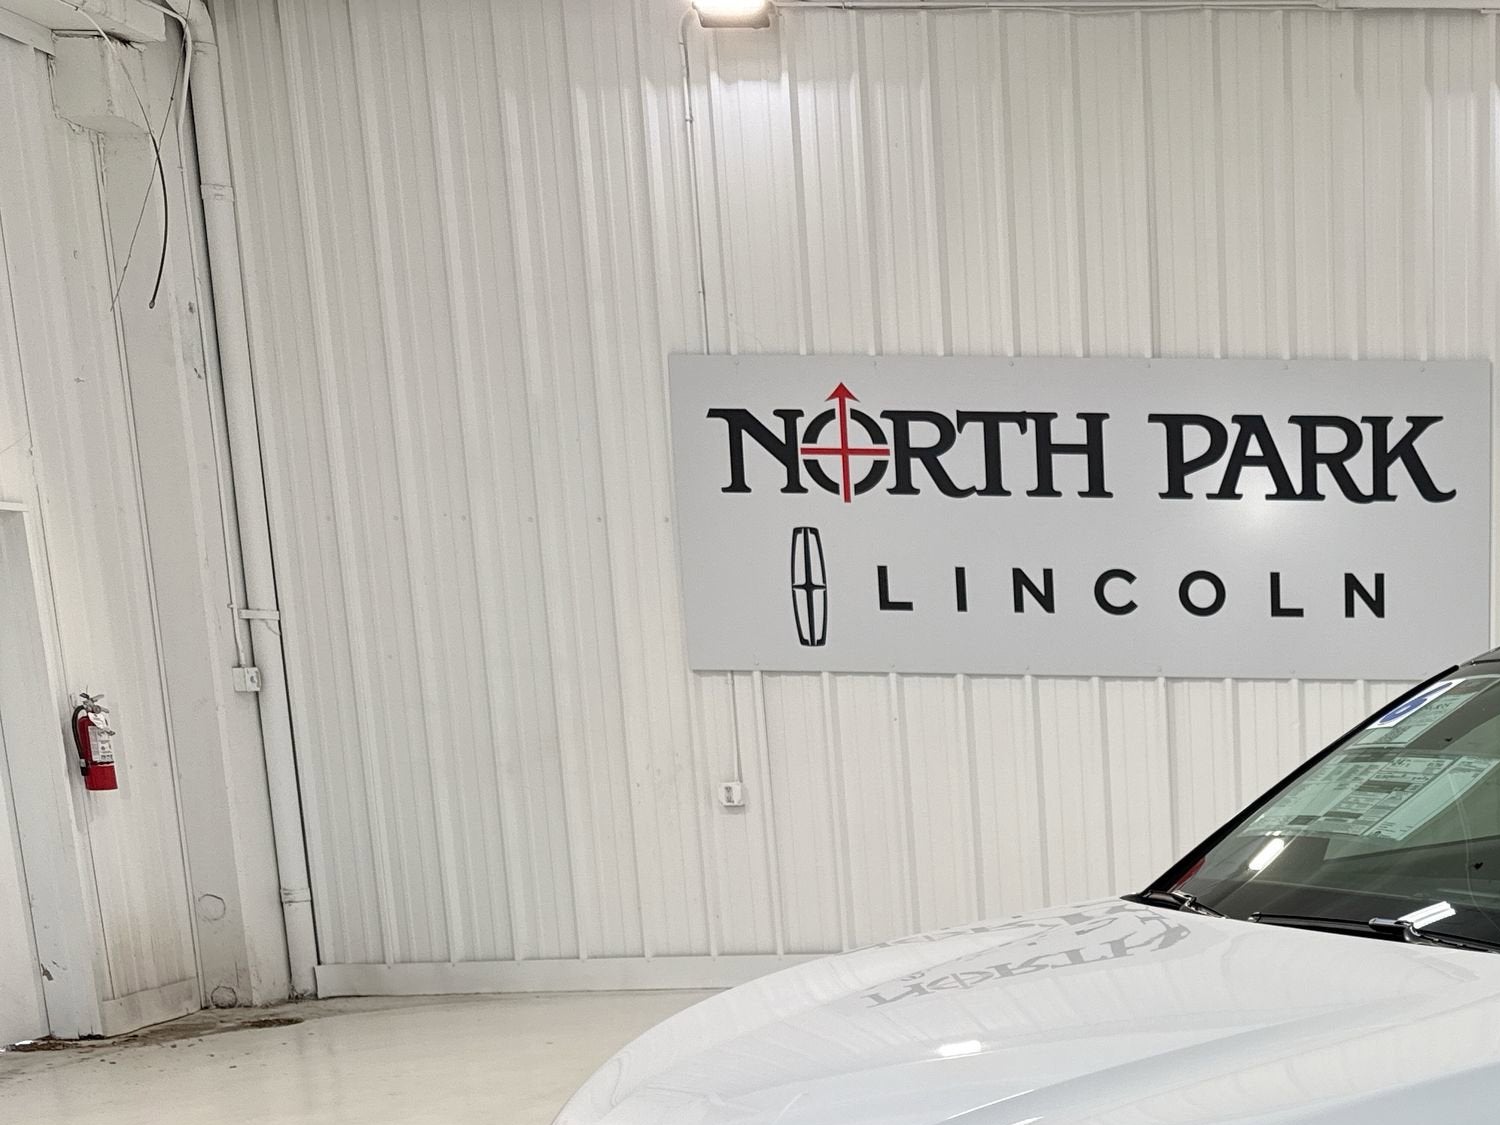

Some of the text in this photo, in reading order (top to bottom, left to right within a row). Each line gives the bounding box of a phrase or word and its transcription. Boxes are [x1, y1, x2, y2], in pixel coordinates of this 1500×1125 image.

[706, 407, 1457, 505] NORTH PARK
[877, 565, 1386, 619] LINCOLN
